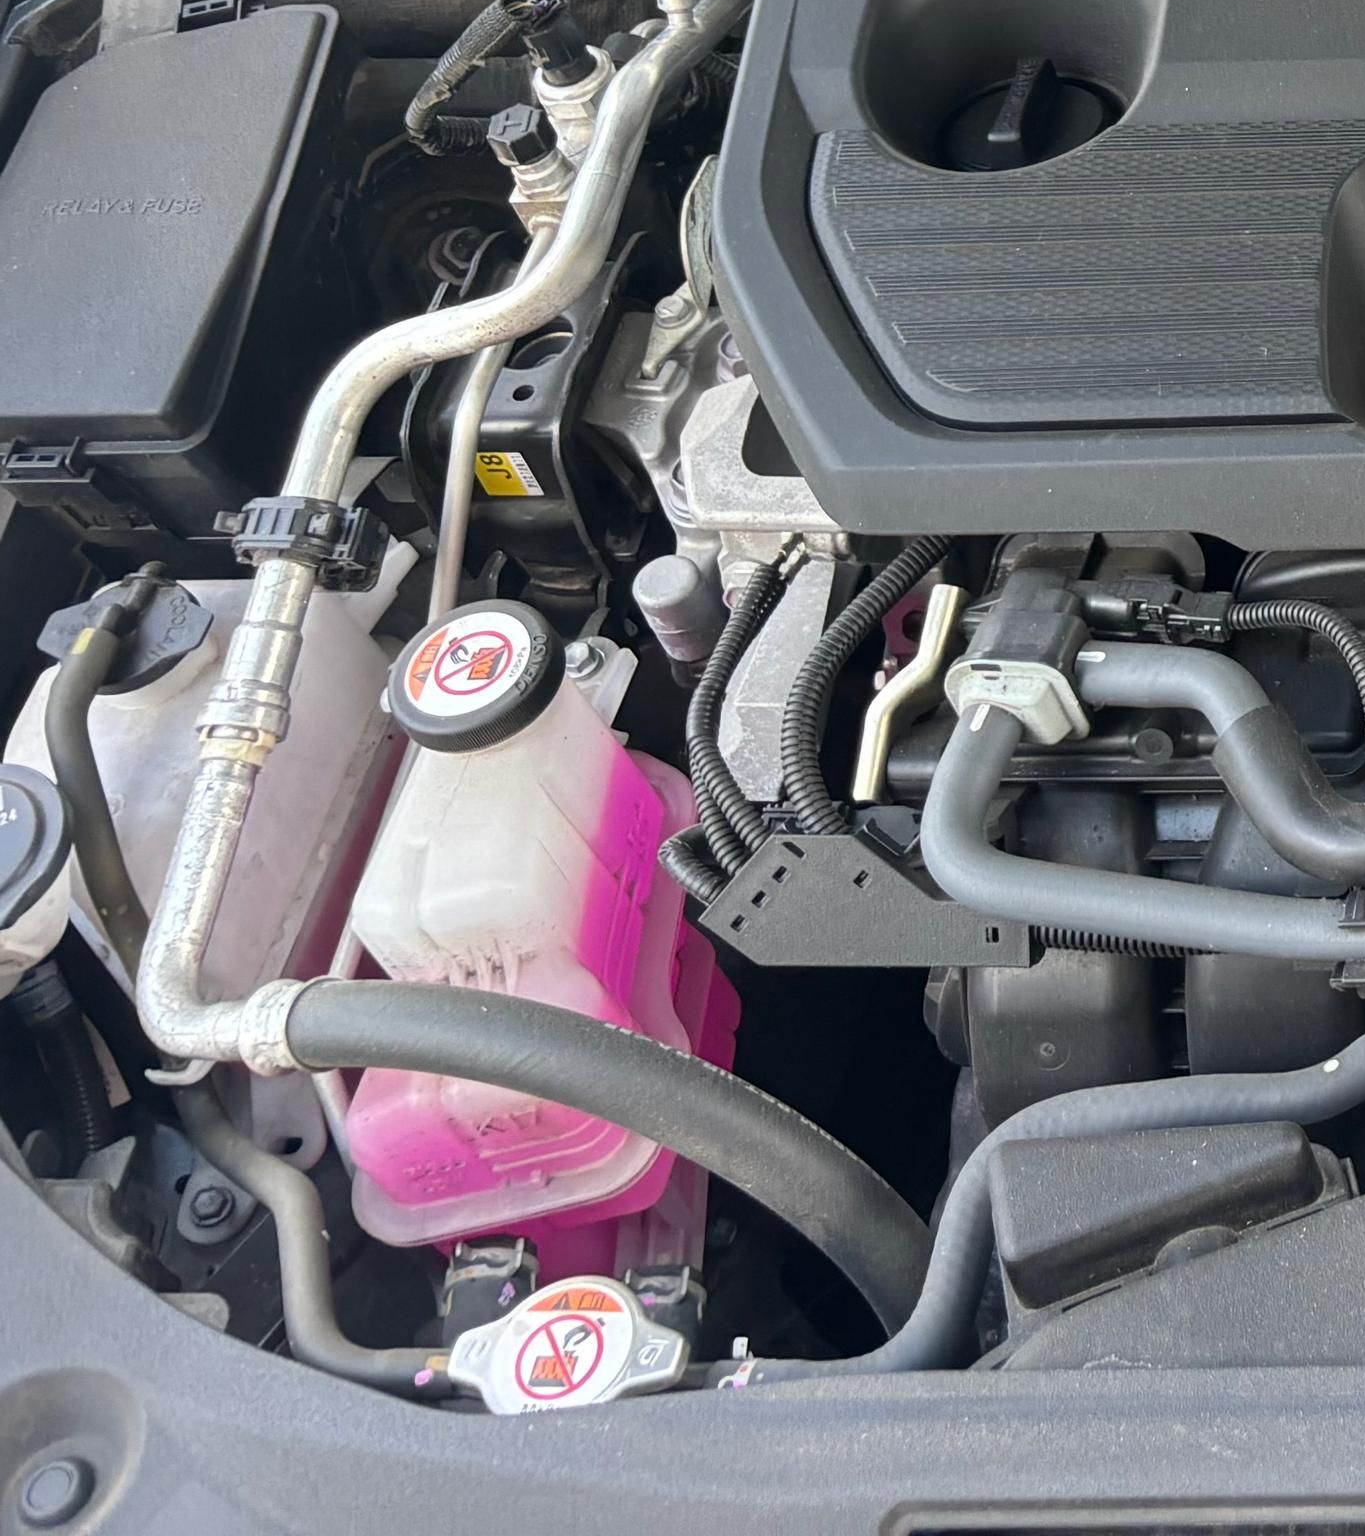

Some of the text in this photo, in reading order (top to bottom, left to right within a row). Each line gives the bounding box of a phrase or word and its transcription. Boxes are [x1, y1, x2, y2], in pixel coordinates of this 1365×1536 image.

[41, 197, 120, 216] RELAY
[141, 197, 205, 215] FUSE
[515, 633, 549, 696] DENSO
